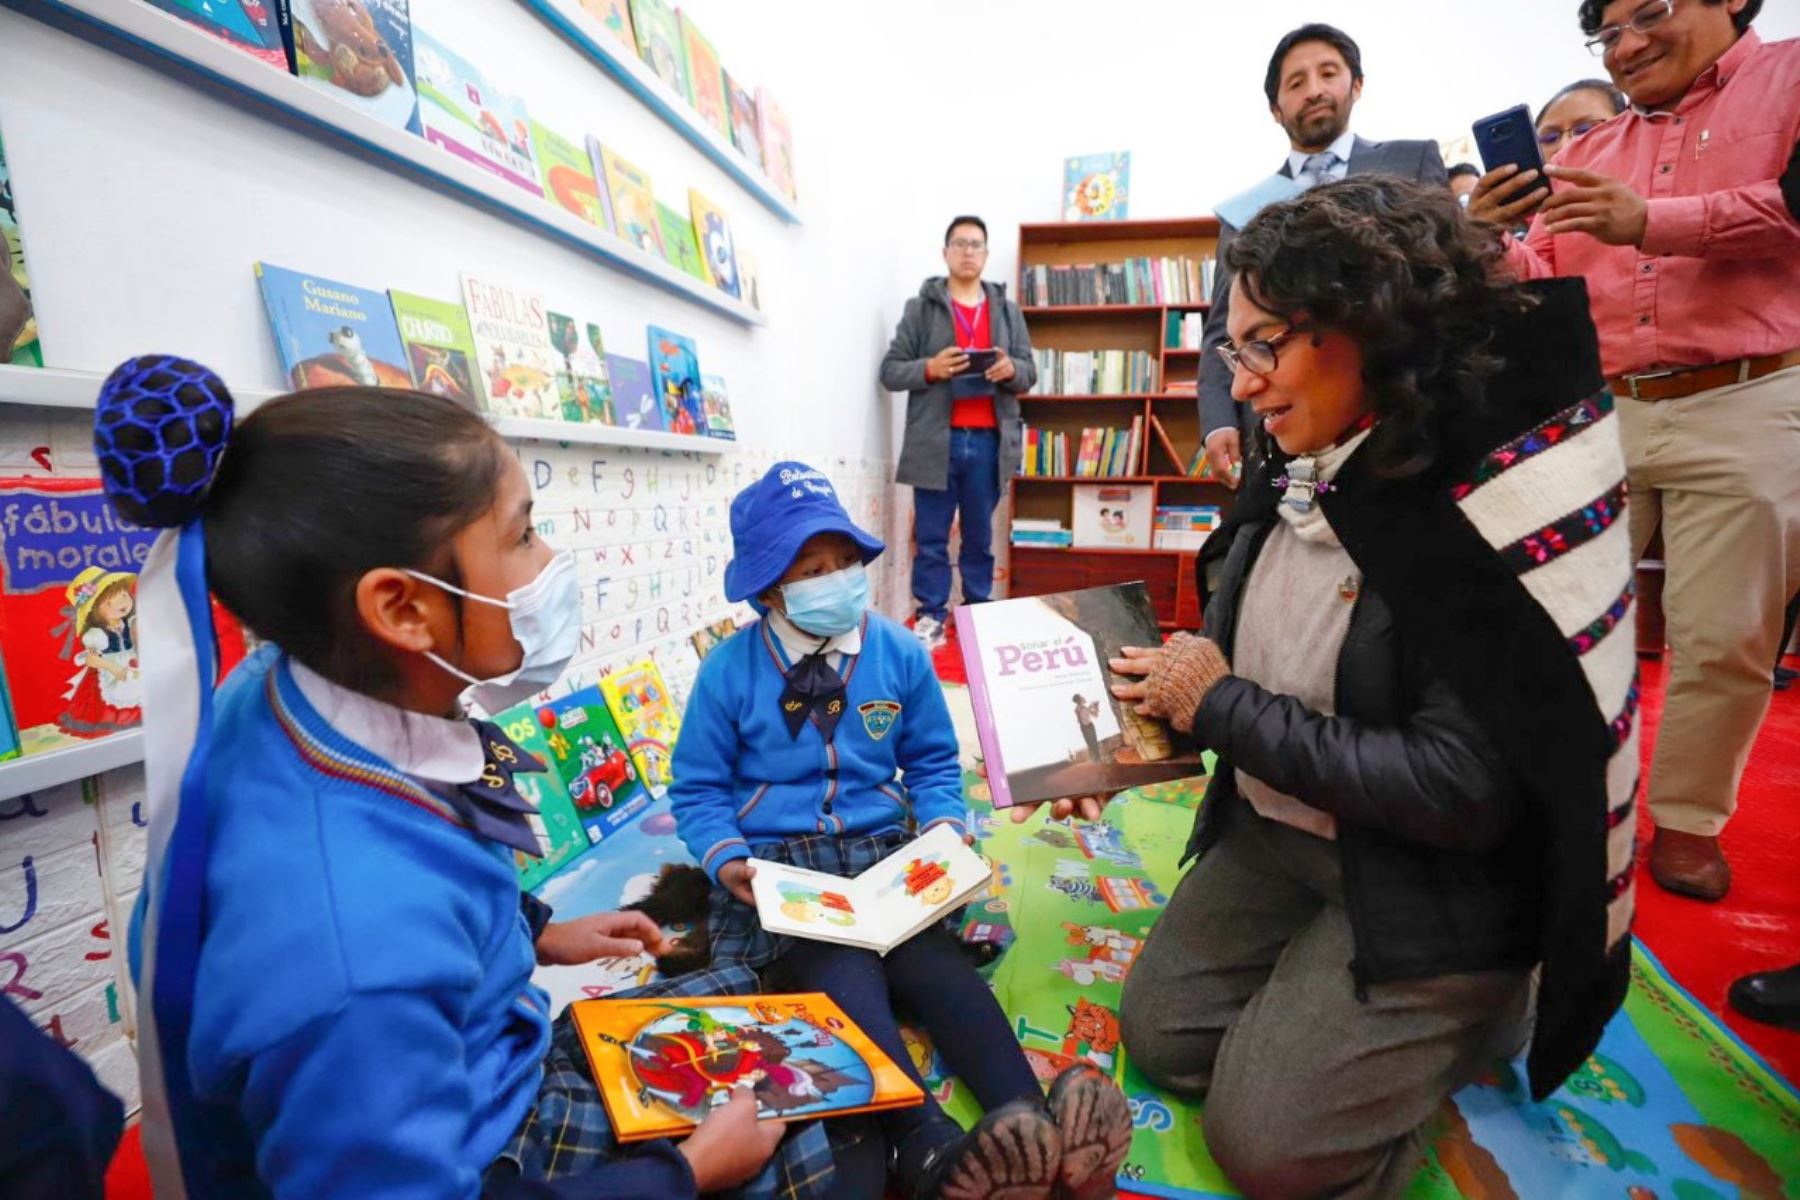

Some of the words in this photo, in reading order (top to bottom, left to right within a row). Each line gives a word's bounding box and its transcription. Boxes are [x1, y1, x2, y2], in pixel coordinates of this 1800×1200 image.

[302, 279, 360, 305] Gusano
[304, 296, 367, 322] Mariano
[534, 459, 552, 490] D
[591, 460, 607, 493] F
[4, 500, 153, 537] fábula
[572, 506, 591, 533] N
[597, 576, 611, 611] F
[580, 623, 596, 653] N
[1053, 636, 1062, 646] el
[994, 636, 1088, 677] Perú
[827, 700, 840, 714] B
[503, 717, 537, 743] OS
[1017, 1016, 1060, 1042] T
